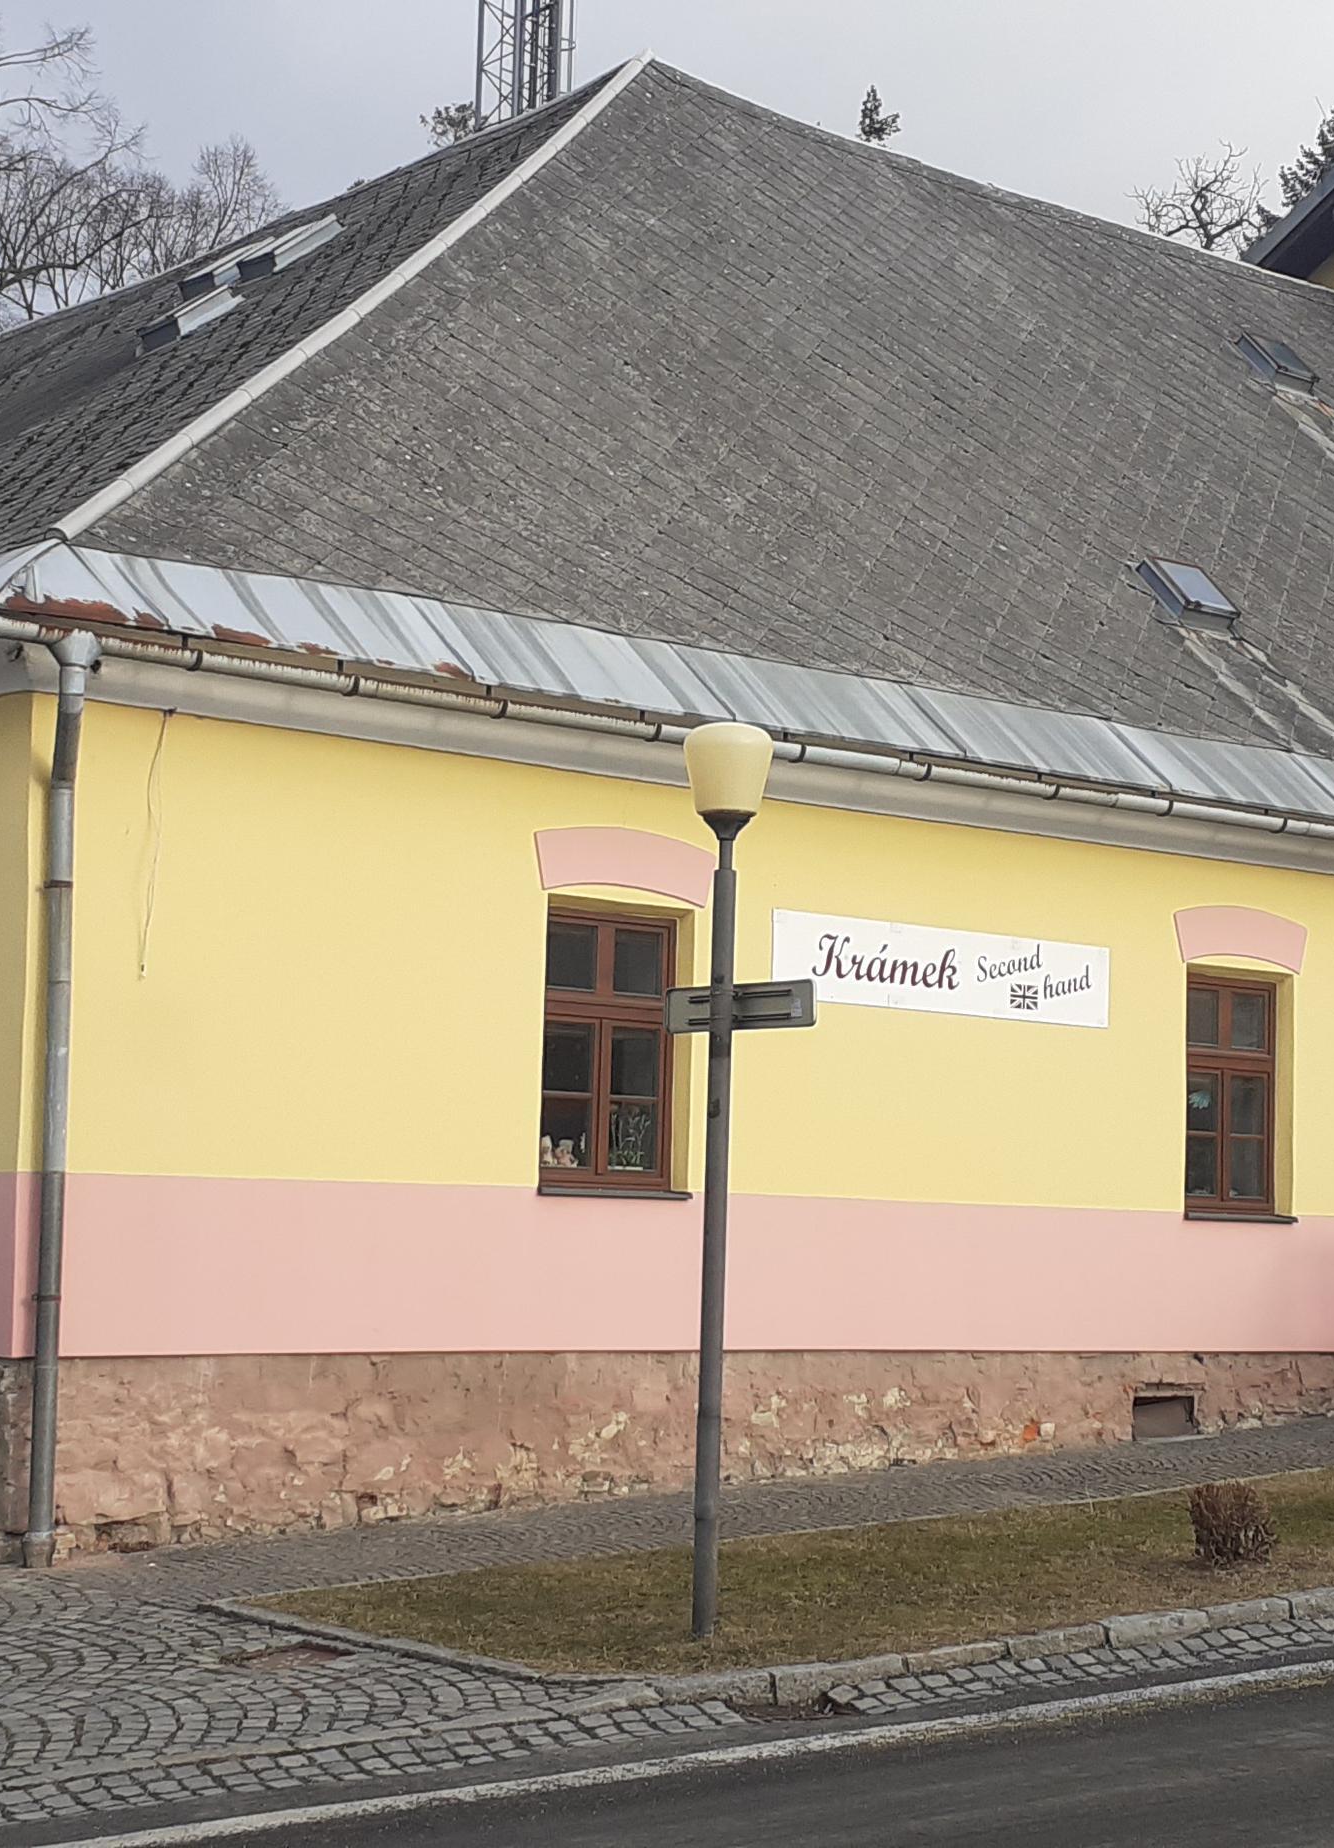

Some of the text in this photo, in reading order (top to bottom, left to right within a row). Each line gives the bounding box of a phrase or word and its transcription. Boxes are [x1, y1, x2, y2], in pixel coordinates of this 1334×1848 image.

[812, 934, 960, 990] Krámek
[977, 944, 1043, 983] Second
[1044, 965, 1093, 1000] hand
